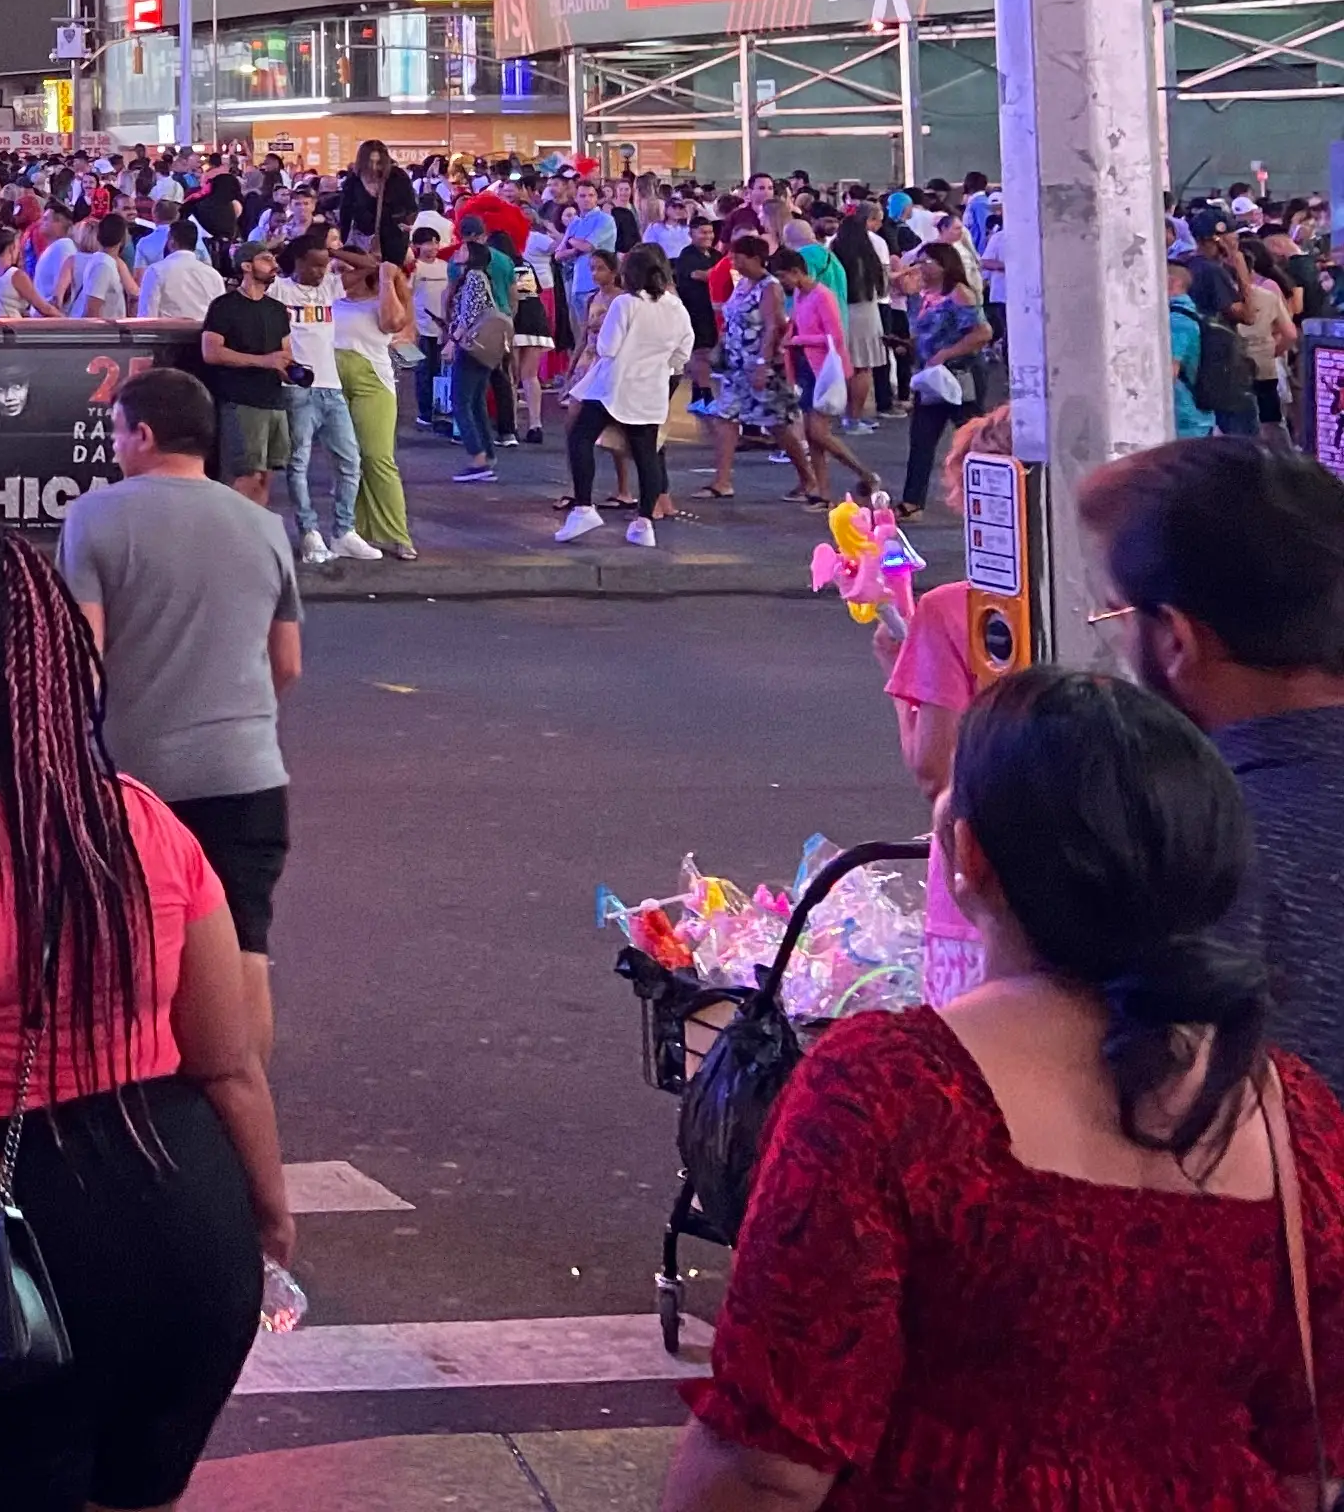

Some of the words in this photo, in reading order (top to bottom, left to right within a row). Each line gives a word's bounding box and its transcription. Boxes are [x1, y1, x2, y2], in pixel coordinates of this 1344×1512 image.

[21, 133, 54, 146] Sale
[287, 304, 332, 323] TRON
[87, 407, 114, 418] YEA
[74, 420, 106, 441] RA
[72, 444, 118, 464] DA
